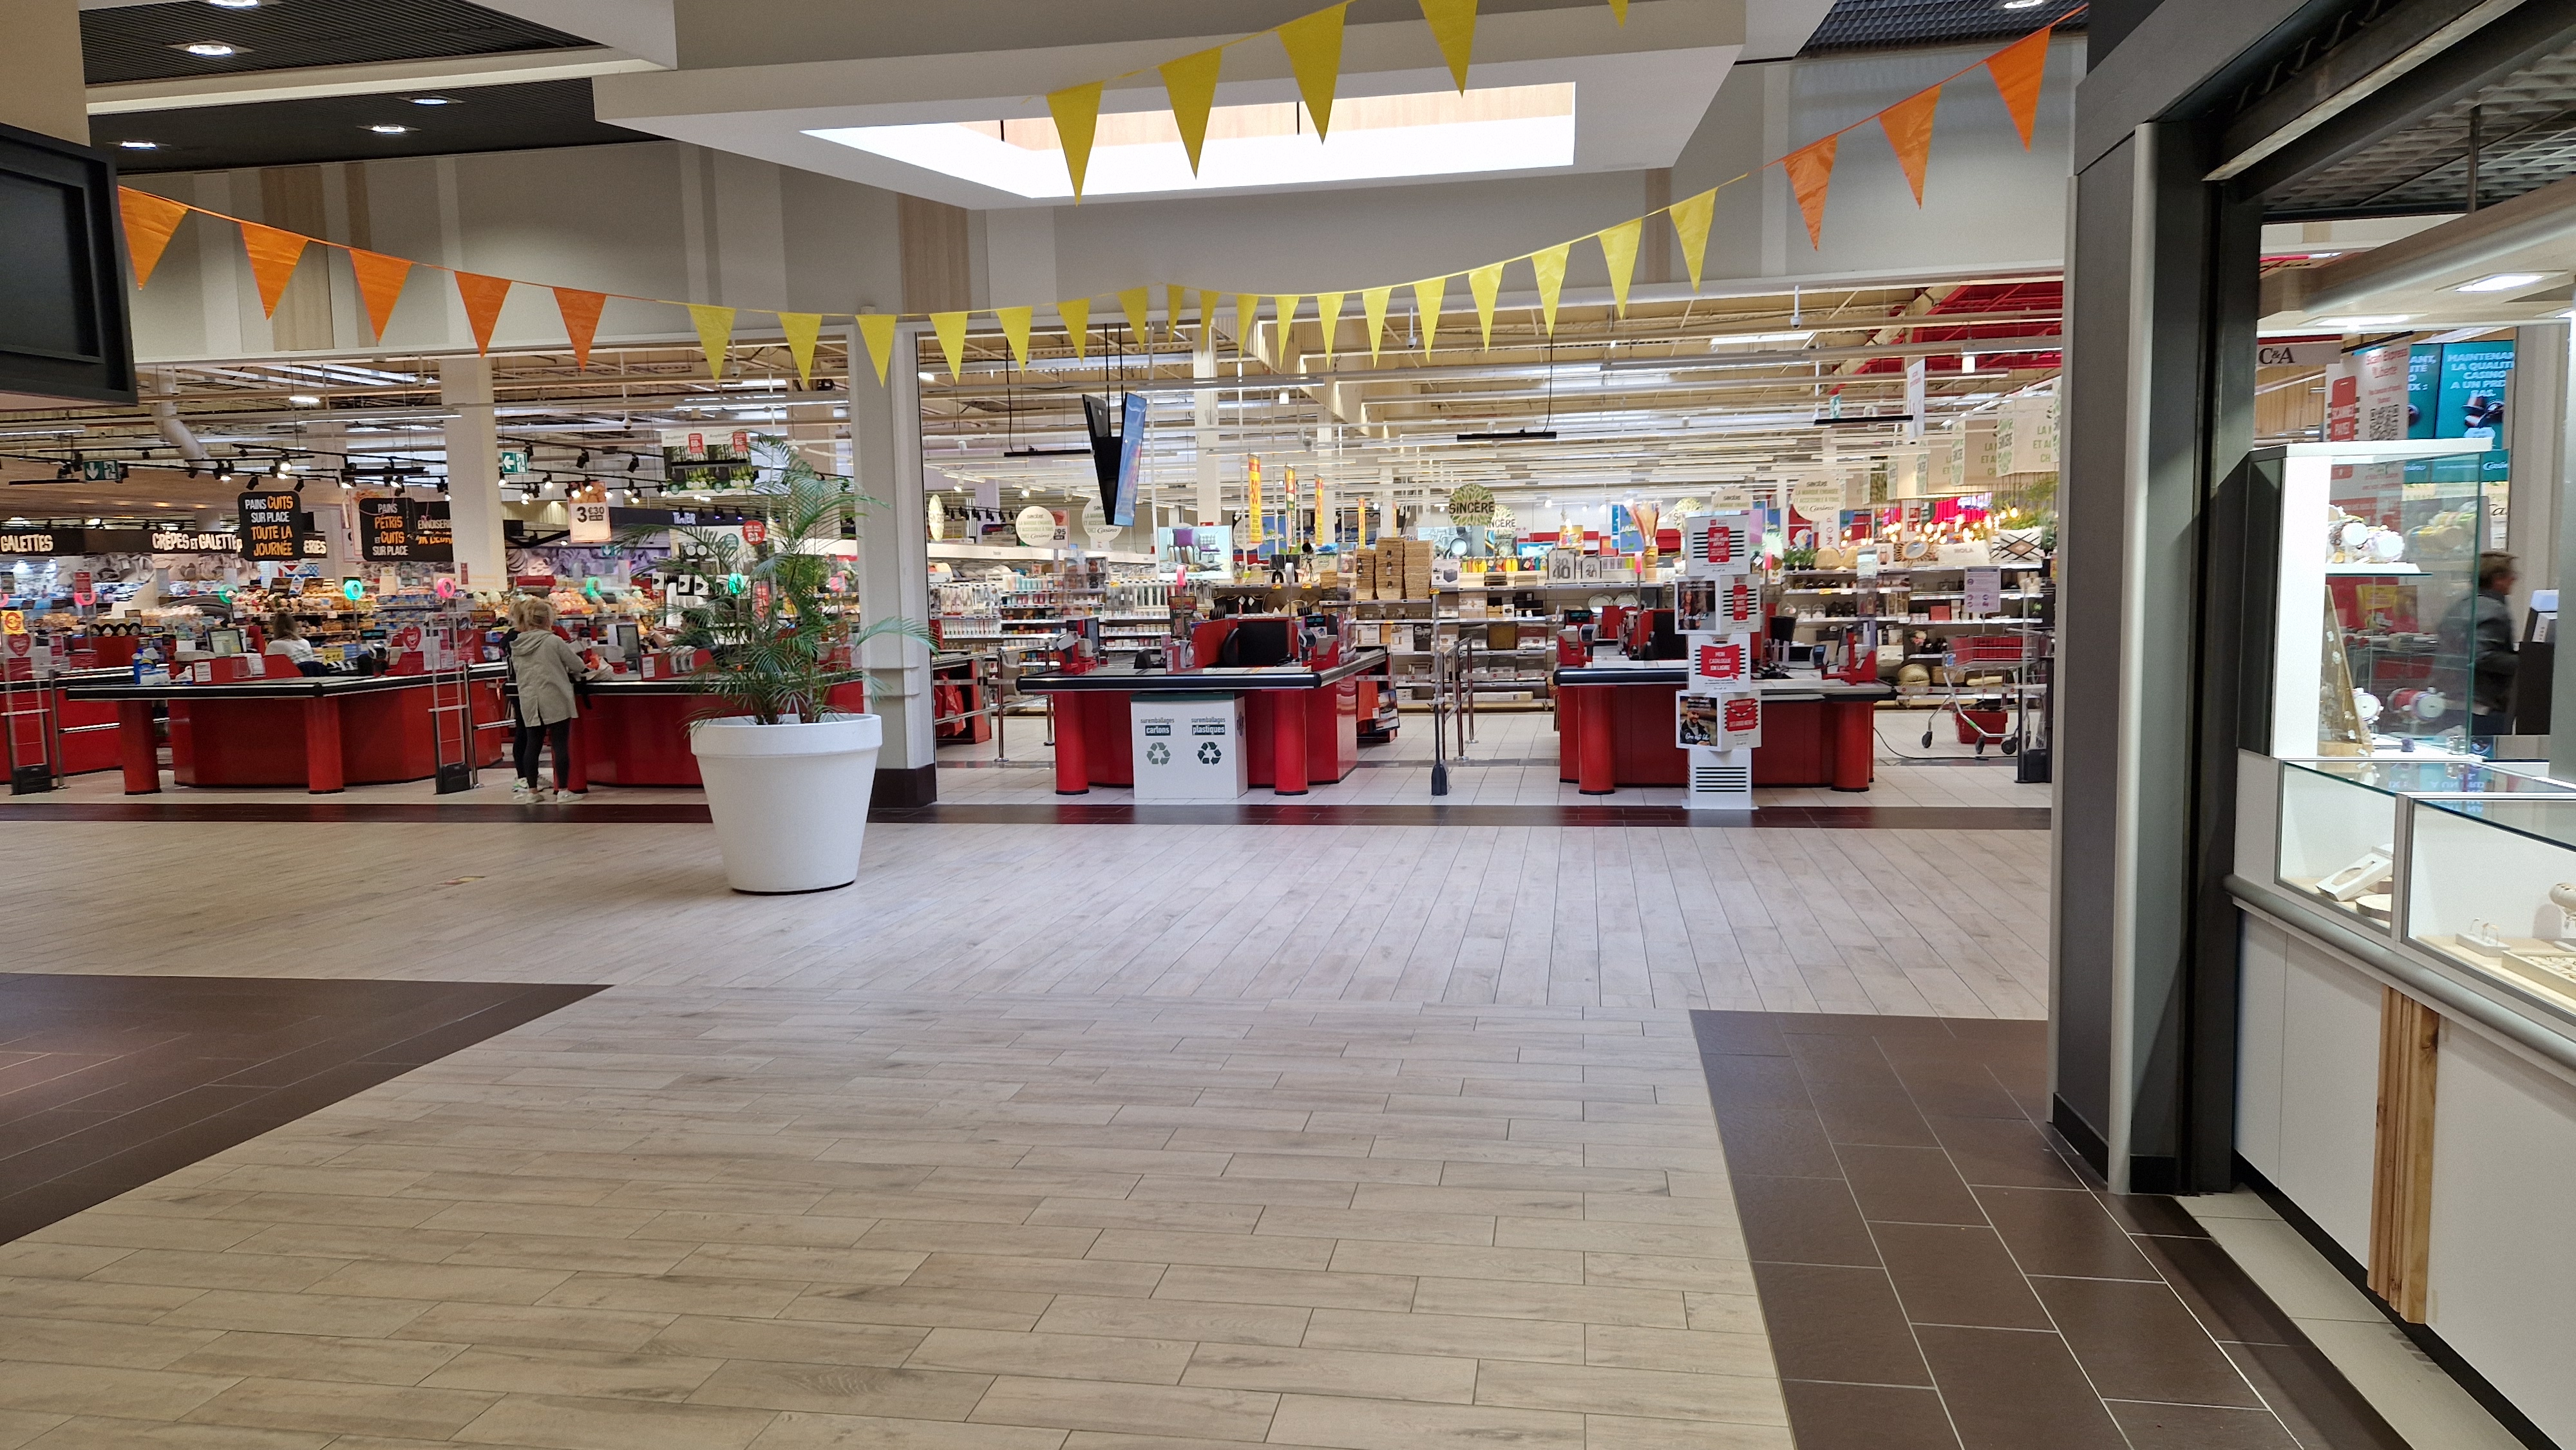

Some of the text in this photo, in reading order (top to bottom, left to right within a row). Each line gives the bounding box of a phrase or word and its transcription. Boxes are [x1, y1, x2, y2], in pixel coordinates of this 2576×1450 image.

[2259, 346, 2295, 365] C&A
[2447, 352, 2515, 362] MAINTENA
[2451, 362, 2467, 371] LA
[2463, 370, 2507, 380] CASINO
[2450, 381, 2461, 390] A
[2462, 380, 2481, 389] UN
[2037, 426, 2047, 435] LA
[2033, 440, 2041, 449] ET
[244, 496, 294, 510] PAINS CUITS
[1448, 500, 1495, 514] SINCÈRE
[377, 504, 398, 514] PAINS
[576, 506, 587, 523] 3
[251, 511, 290, 523] SUR PLACE
[374, 514, 403, 529] PÉTRIS
[1486, 517, 1516, 528] INCÈRE
[251, 525, 293, 540] TOUTE LA
[380, 531, 405, 544] CUITS
[0, 534, 53, 552] GALETTES
[152, 532, 190, 551] CRÊPES
[190, 538, 198, 550] ET
[198, 533, 237, 551] GALETTE
[253, 540, 294, 557] JOURNÉE
[372, 545, 409, 556] SUR PLACE
[1191, 716, 1226, 724] suremballages
[1146, 726, 1170, 734] cartons
[1192, 724, 1225, 735] plastiques
